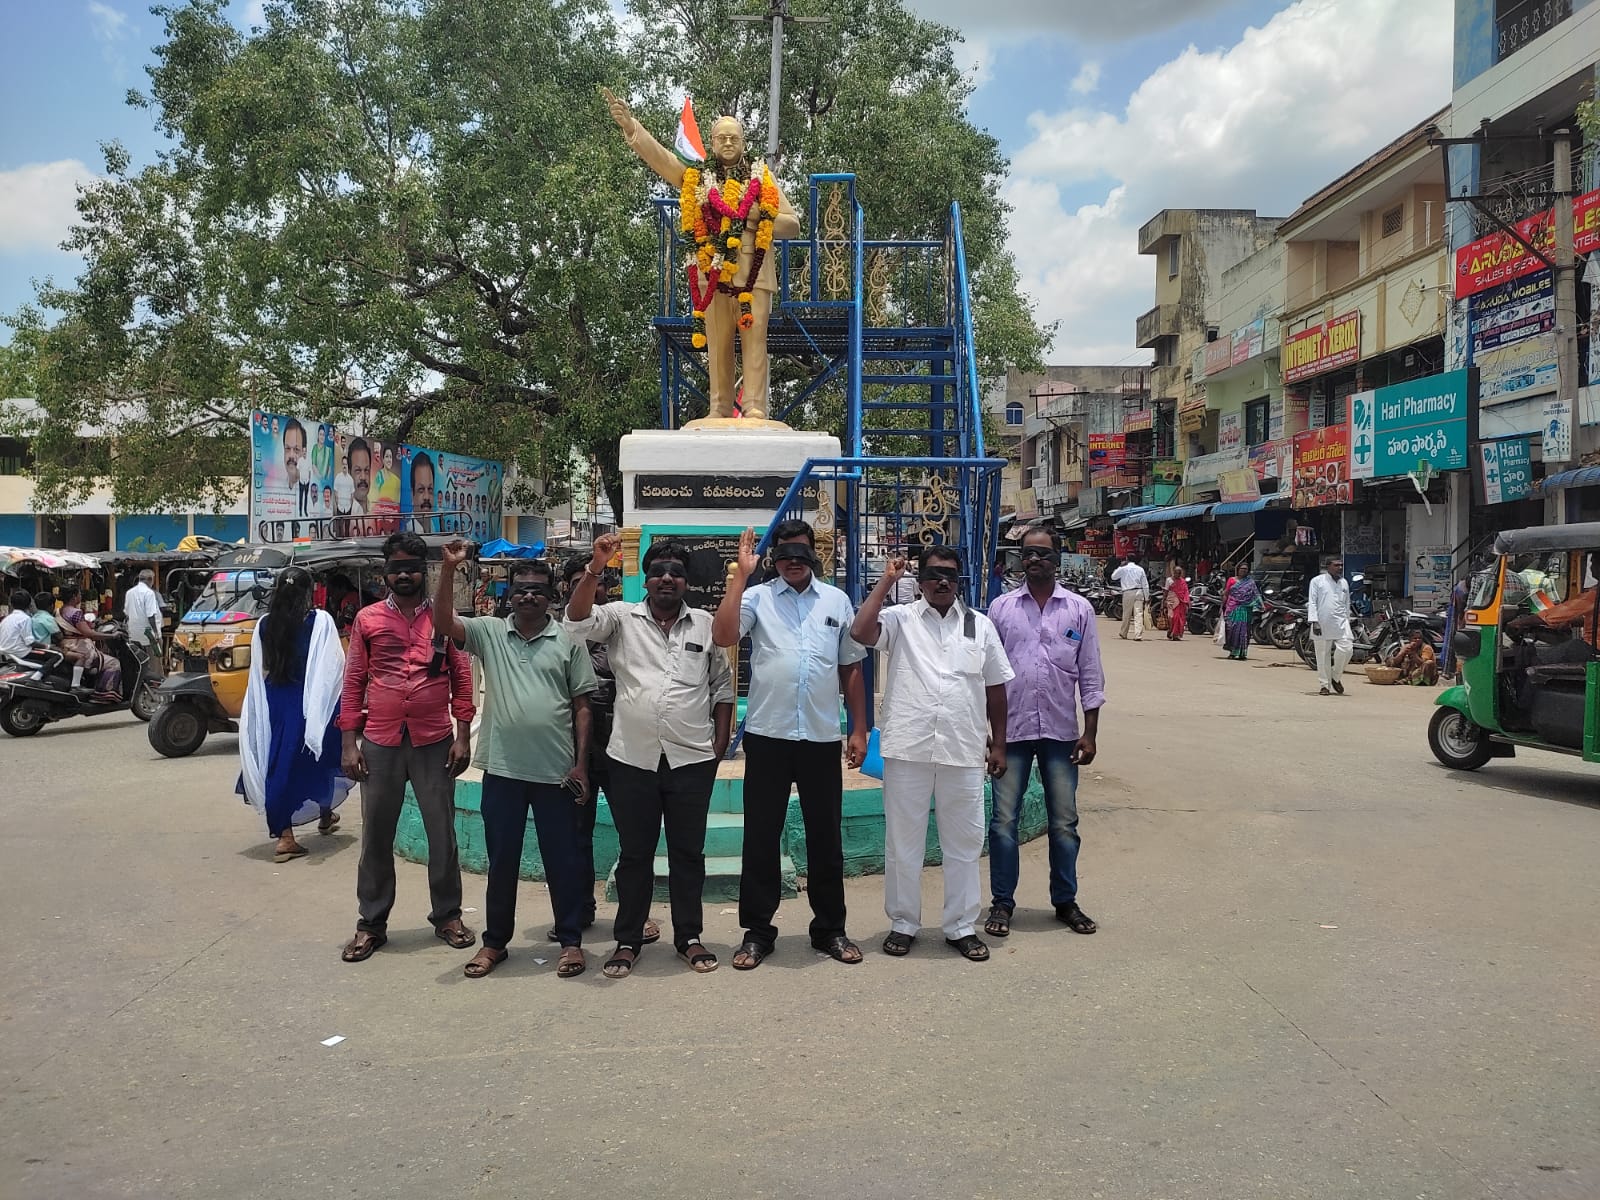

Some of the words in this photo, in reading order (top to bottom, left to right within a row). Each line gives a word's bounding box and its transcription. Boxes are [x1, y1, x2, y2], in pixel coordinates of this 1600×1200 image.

[1475, 270, 1504, 286] SALES
[1511, 278, 1552, 299] MOBILES
[1286, 332, 1322, 370] INTERNET
[1328, 318, 1357, 355] XEROX
[1381, 399, 1401, 421] Hari
[1404, 392, 1457, 417] Pharmacy
[1089, 441, 1124, 450] INTERNET
[1387, 437, 1409, 456] హరి
[1499, 441, 1523, 458] Hari
[1503, 457, 1530, 467] Pharmacy
